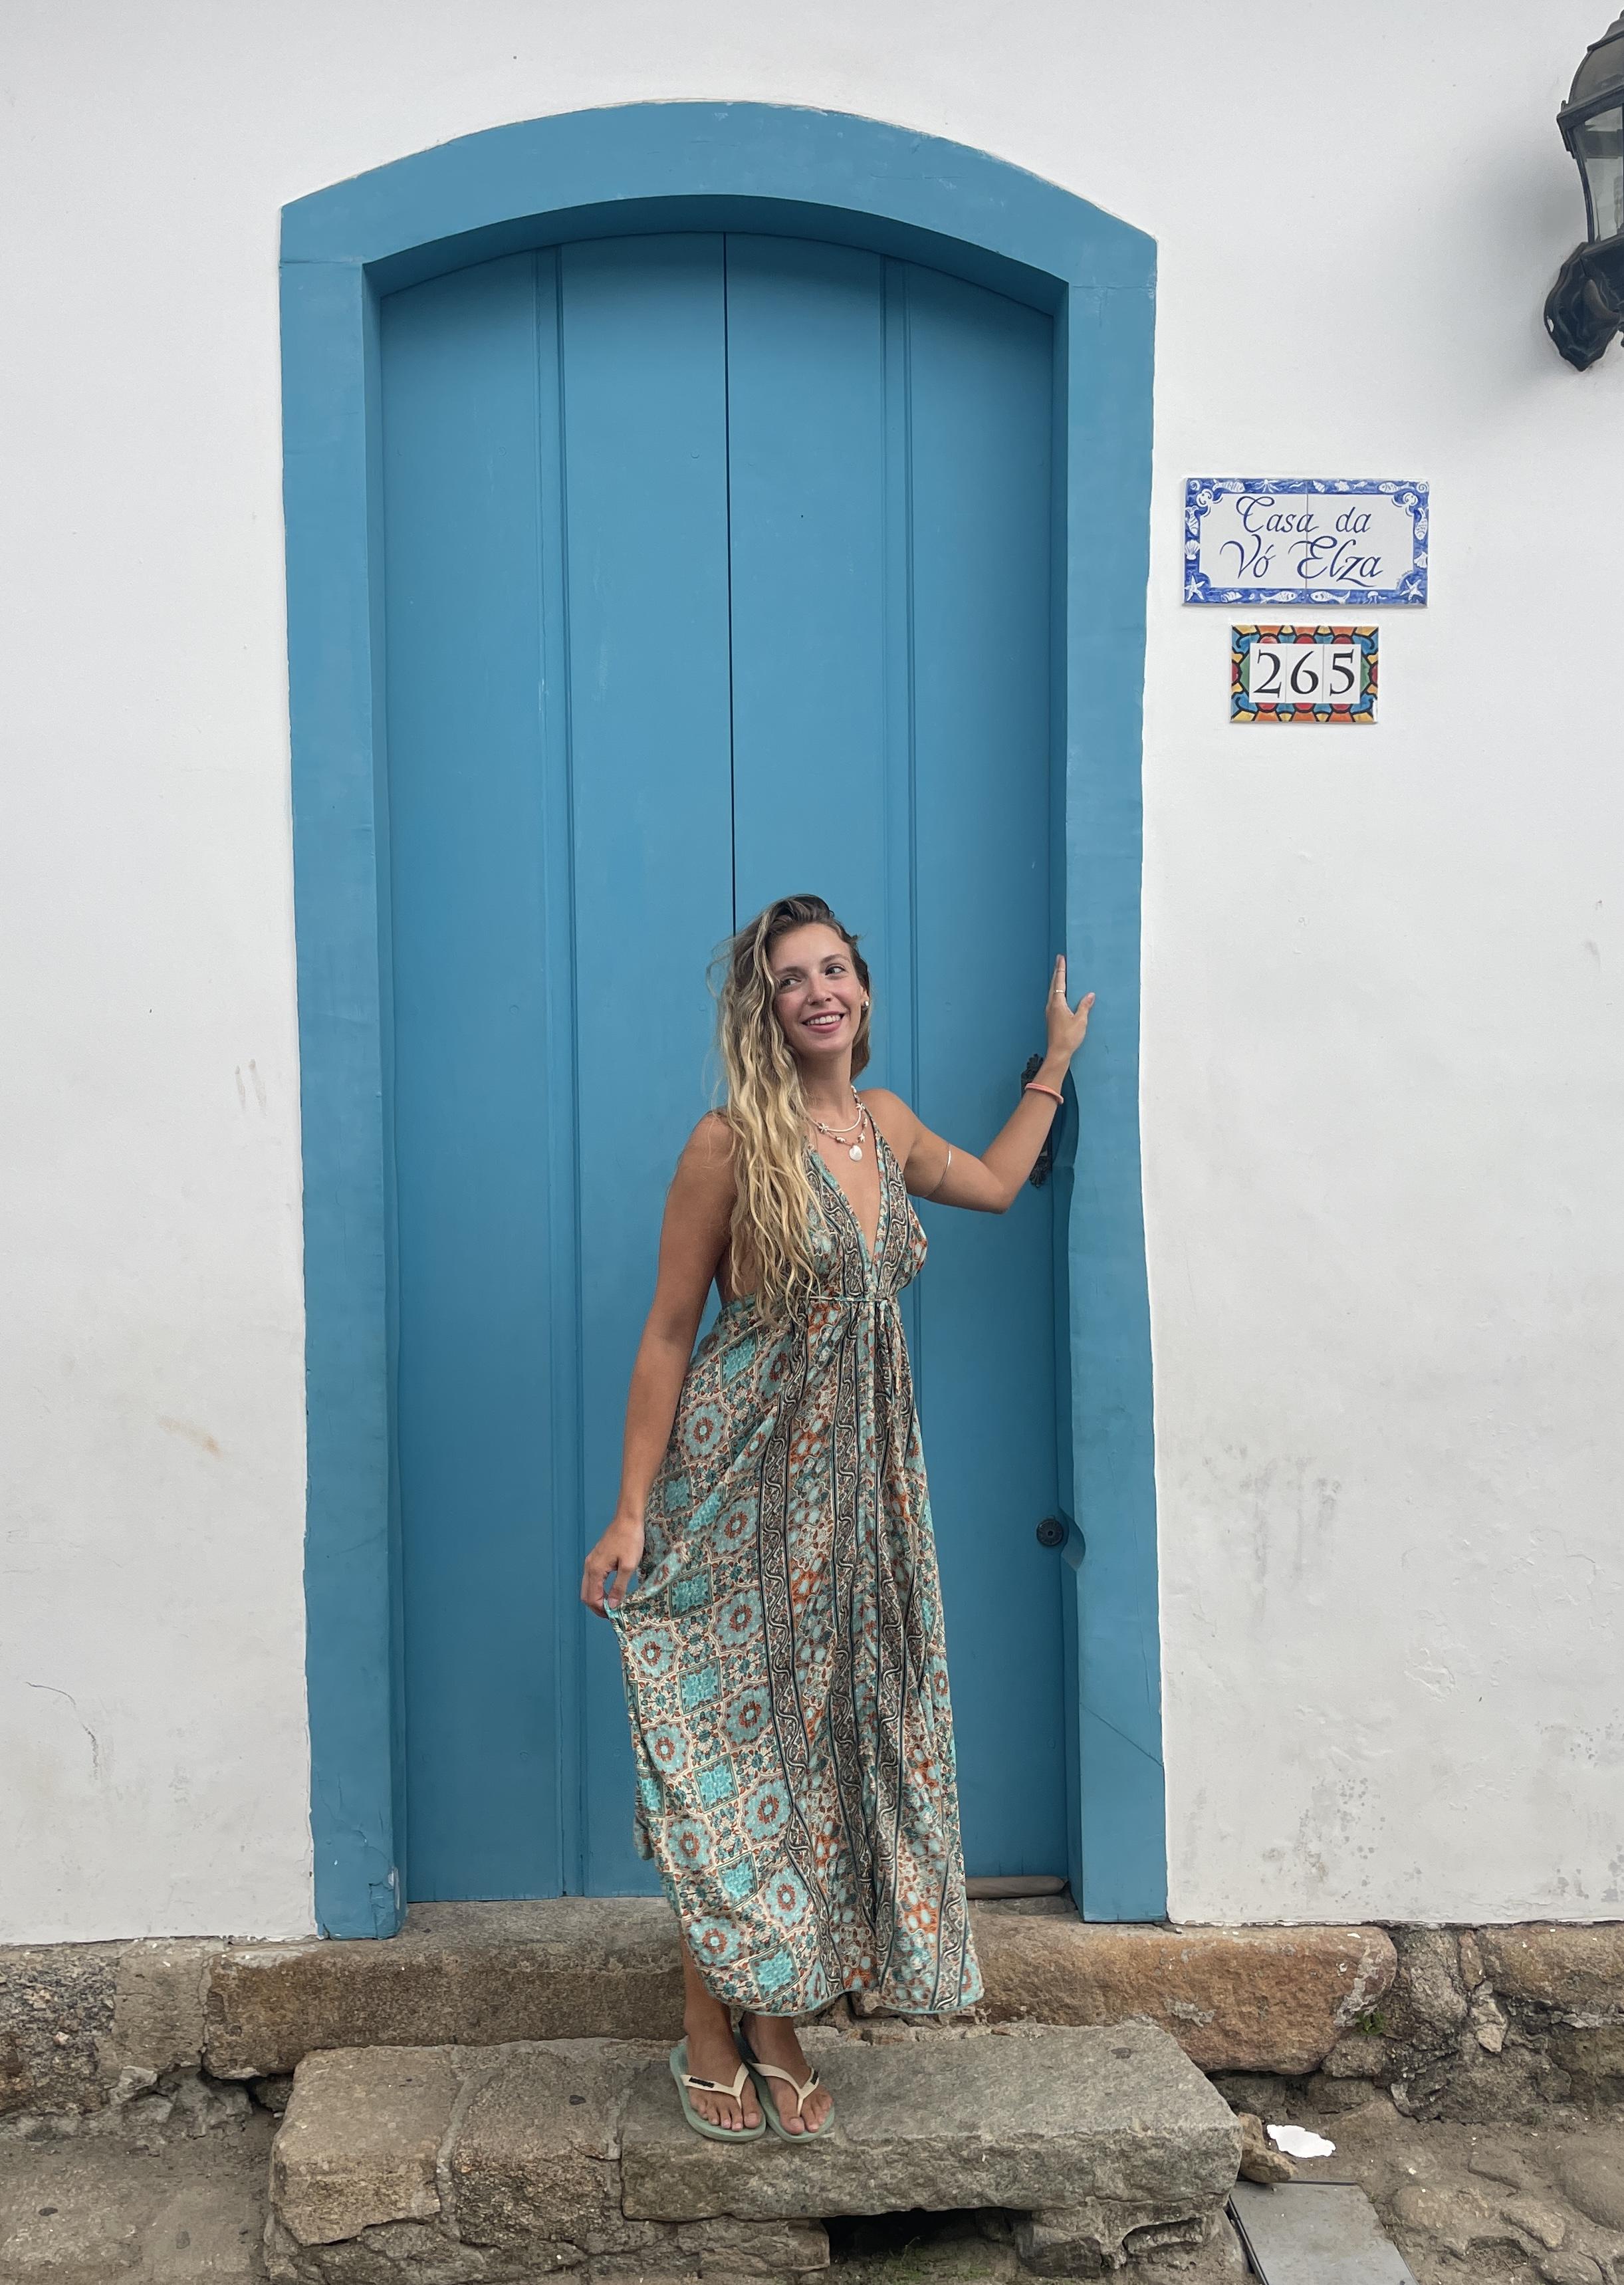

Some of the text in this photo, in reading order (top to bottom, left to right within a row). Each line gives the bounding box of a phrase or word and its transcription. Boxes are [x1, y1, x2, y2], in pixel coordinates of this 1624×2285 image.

[1236, 495, 1372, 533] Casa da
[1219, 534, 1383, 587] Vó Elza
[1253, 648, 1355, 698] 265
